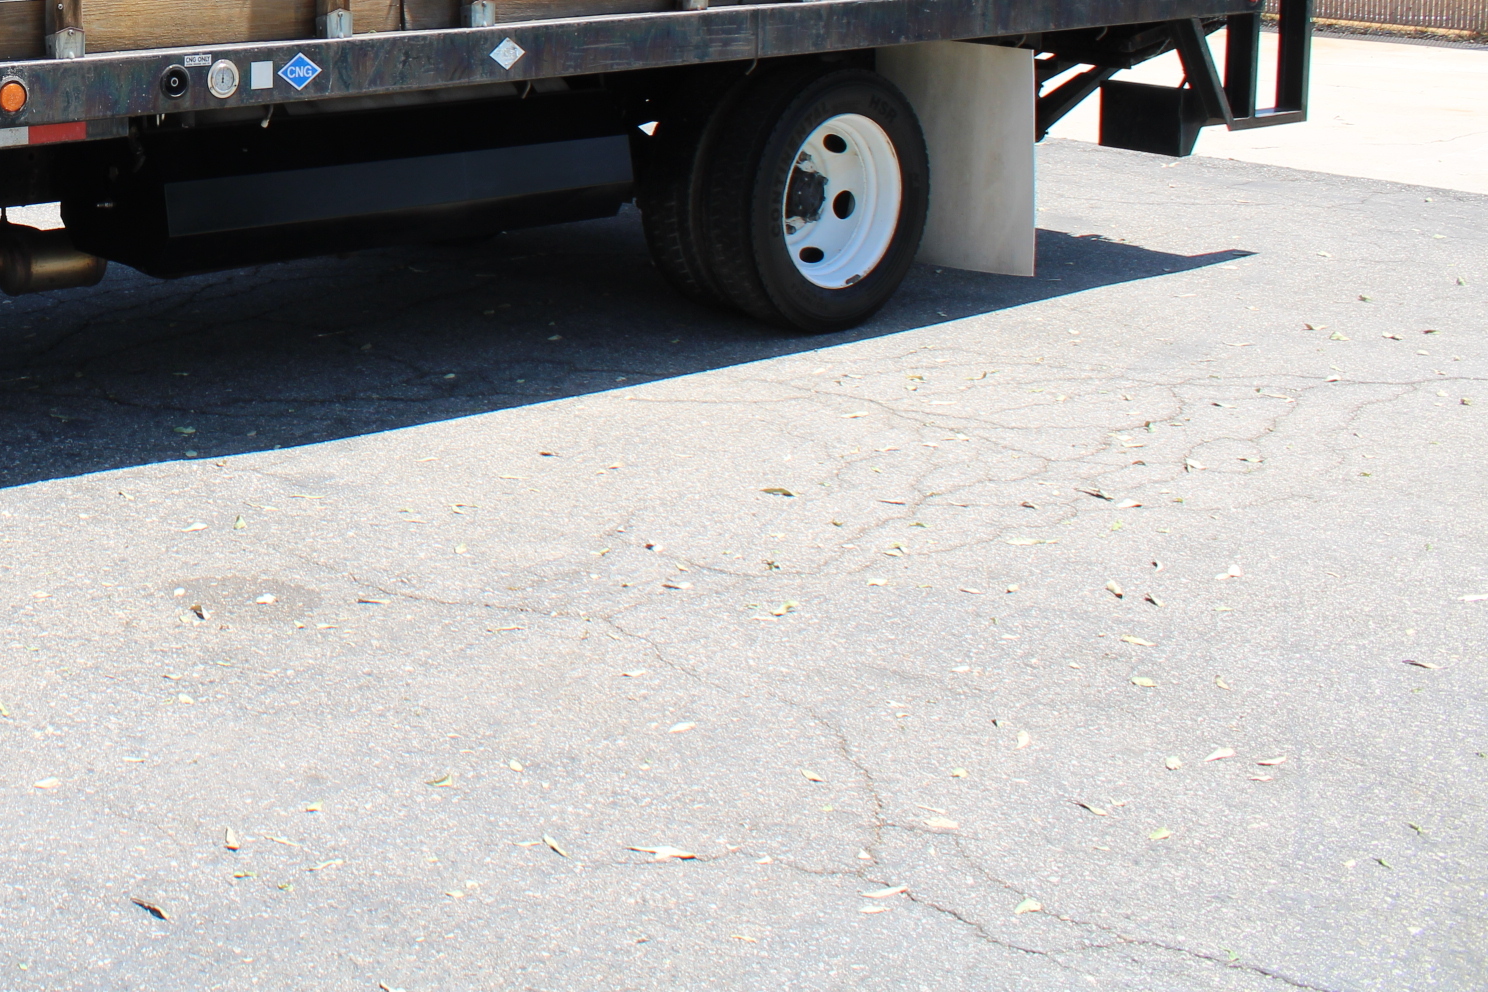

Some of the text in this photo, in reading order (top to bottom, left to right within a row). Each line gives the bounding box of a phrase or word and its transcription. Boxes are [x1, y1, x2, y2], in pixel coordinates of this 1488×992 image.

[198, 55, 210, 63] ONLY
[286, 65, 312, 79] CNG
[868, 93, 898, 124] HSR
